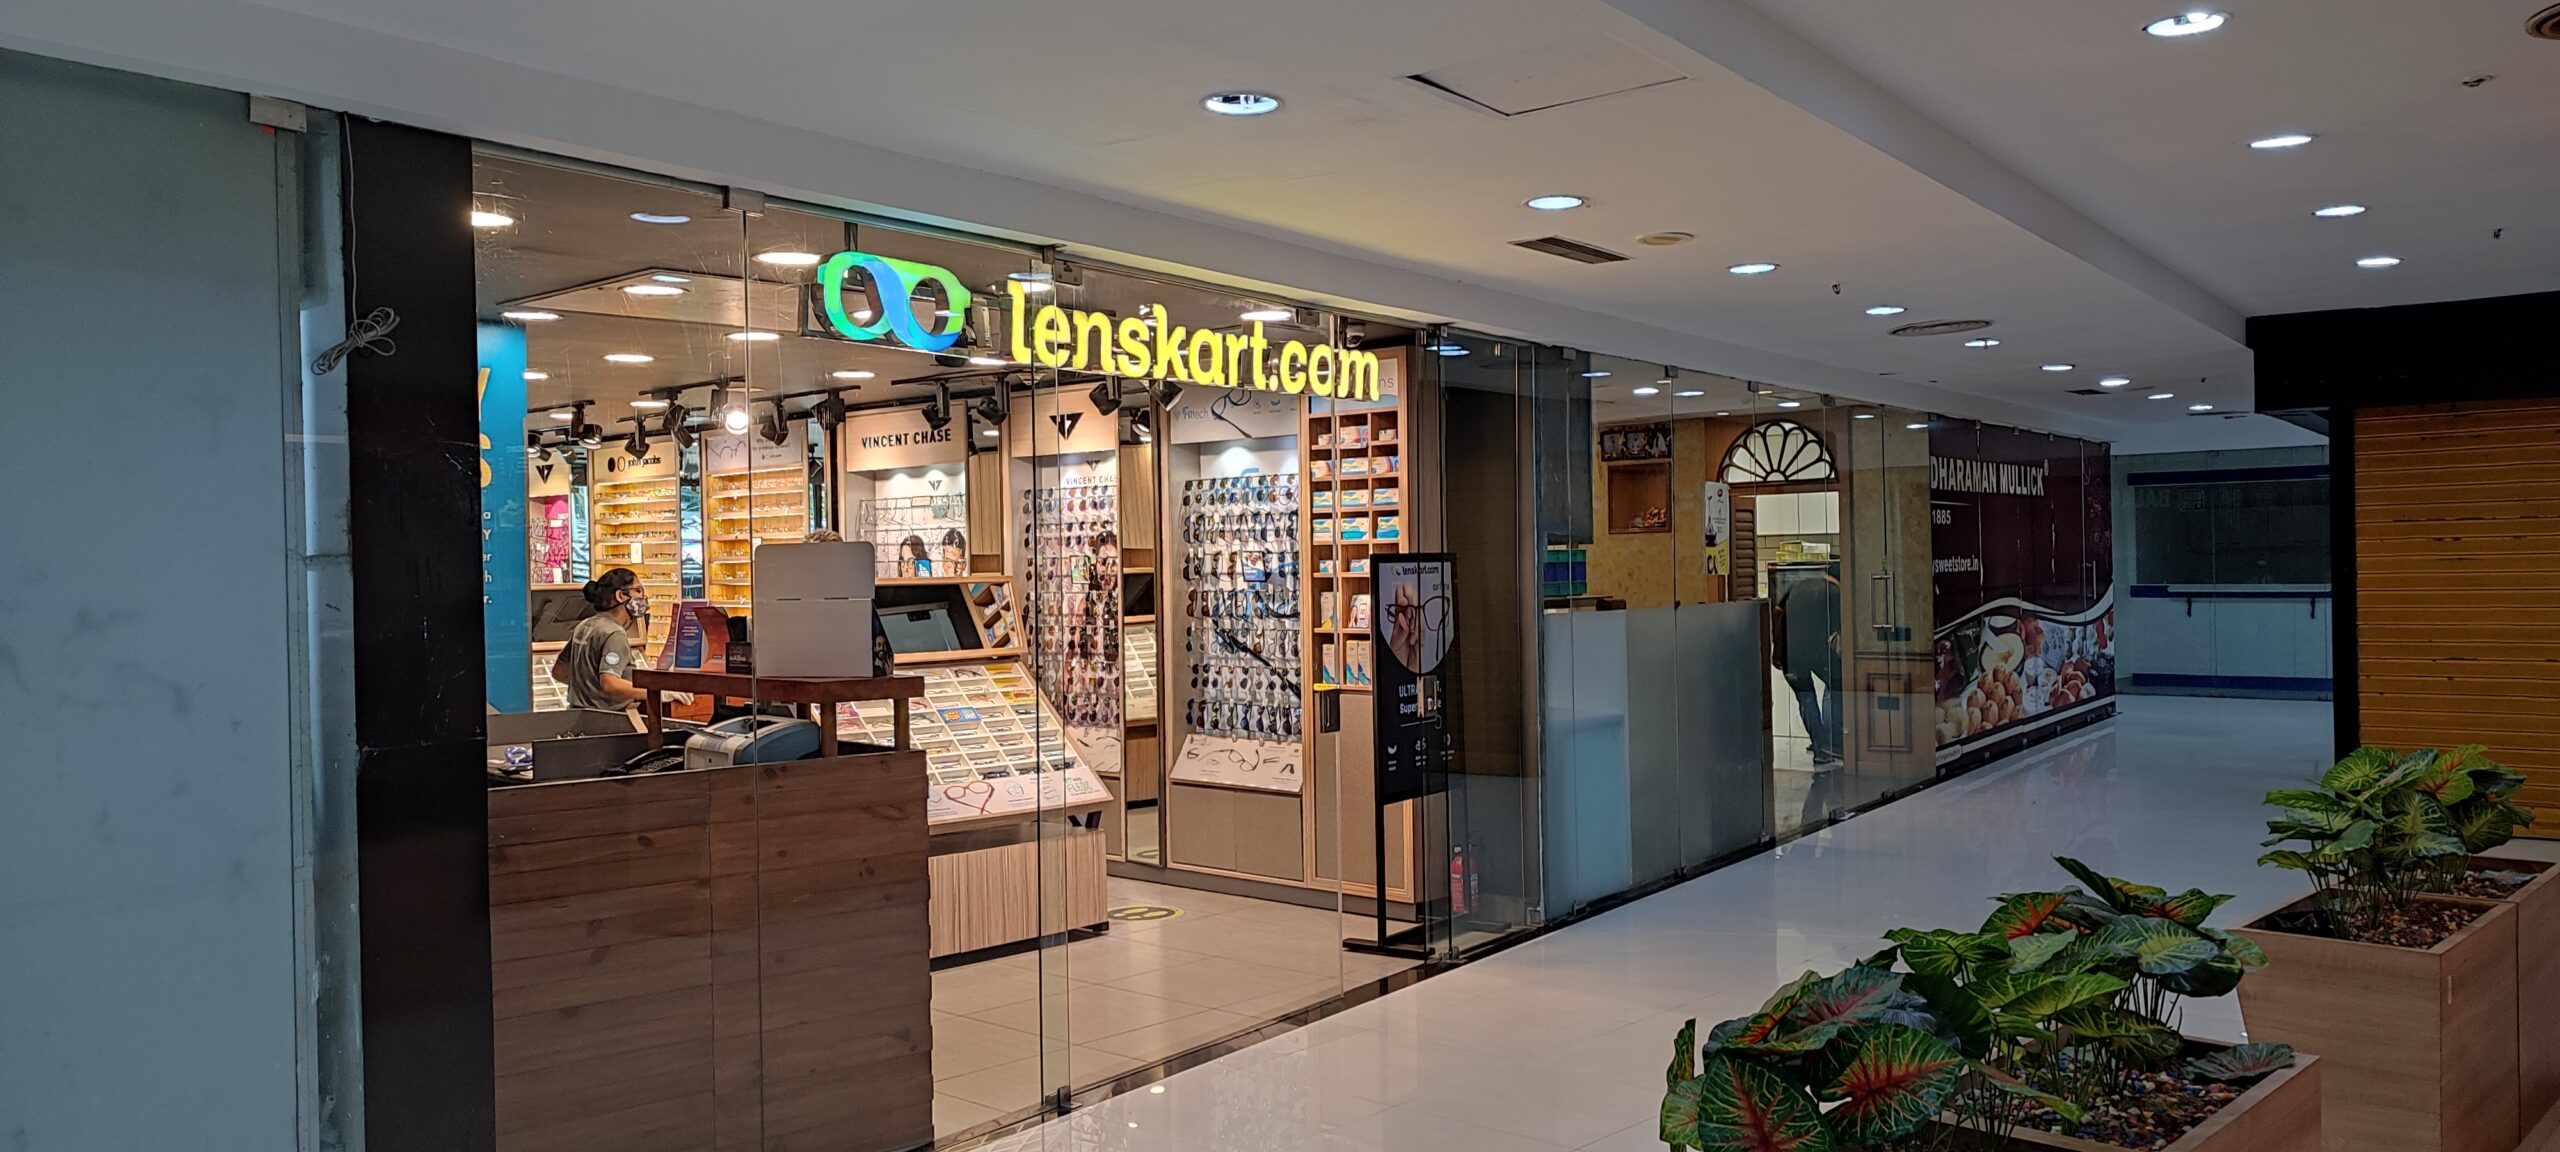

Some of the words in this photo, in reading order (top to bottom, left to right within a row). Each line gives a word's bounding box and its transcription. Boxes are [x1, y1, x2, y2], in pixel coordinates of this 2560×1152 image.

[1008, 279, 1380, 402] lenskart.com
[861, 433, 909, 449] VINCENT
[913, 429, 952, 445] CHASE
[1065, 475, 1096, 486] VINCENT
[1930, 455, 1997, 494] DHARAMAN
[1931, 509, 1952, 525] 1885
